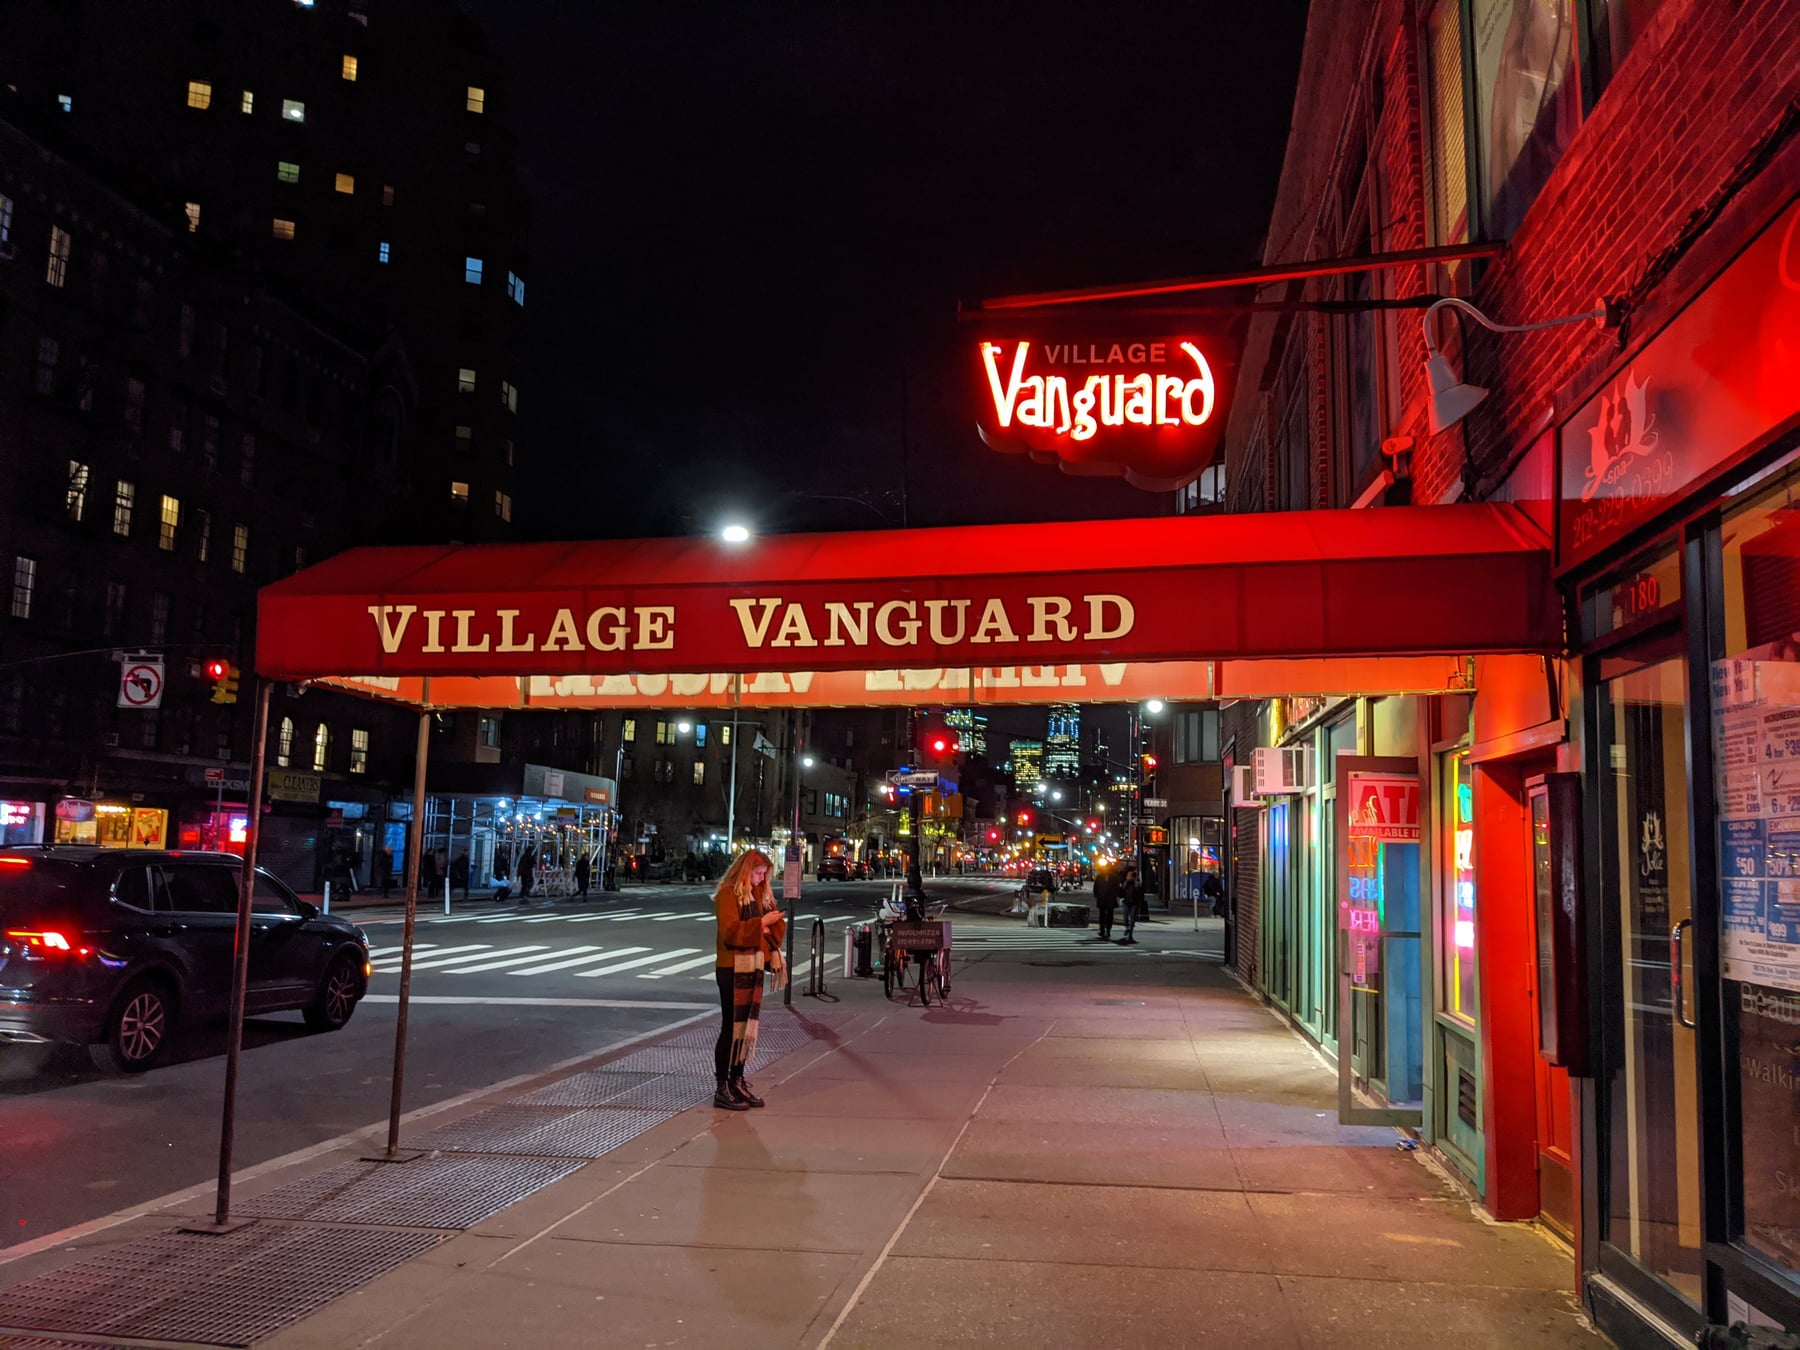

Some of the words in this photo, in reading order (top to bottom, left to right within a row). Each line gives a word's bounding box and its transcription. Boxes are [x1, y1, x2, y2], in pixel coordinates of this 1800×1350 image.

[1044, 343, 1167, 364] VILLAGE
[979, 341, 1215, 441] Vanguard
[1630, 576, 1658, 613] 180
[367, 604, 675, 653] VILLAGE
[729, 594, 1135, 648] VANGUARD
